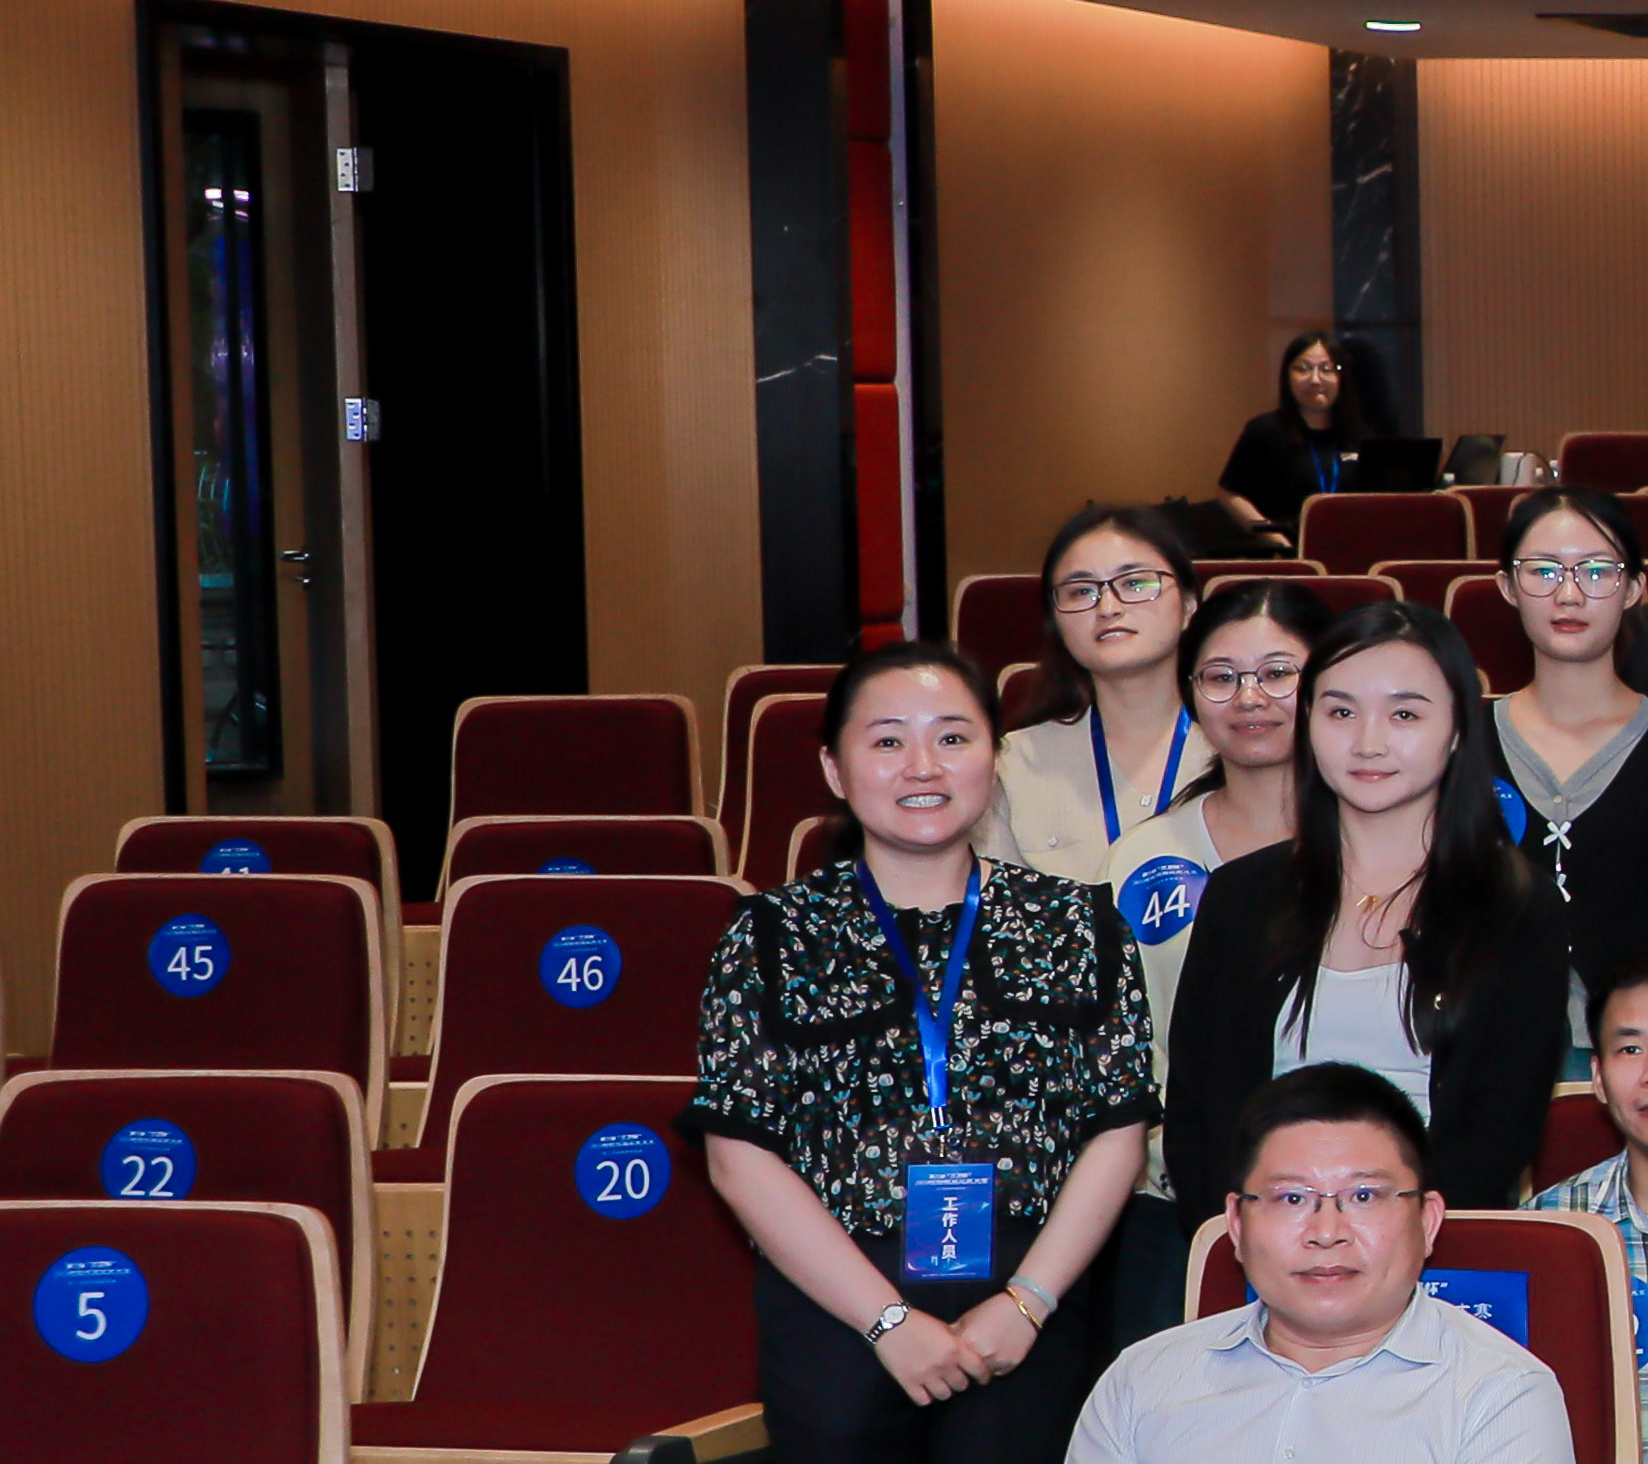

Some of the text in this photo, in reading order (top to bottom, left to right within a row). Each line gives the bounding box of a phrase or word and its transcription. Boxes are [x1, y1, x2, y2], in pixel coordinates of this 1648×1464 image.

[1141, 884, 1191, 928] 44
[167, 945, 213, 980] 45
[556, 955, 604, 992] 46
[121, 1155, 174, 1197] 22
[596, 1158, 650, 1202] 20
[941, 1196, 959, 1260] 工作人员
[76, 1291, 108, 1341] 5
